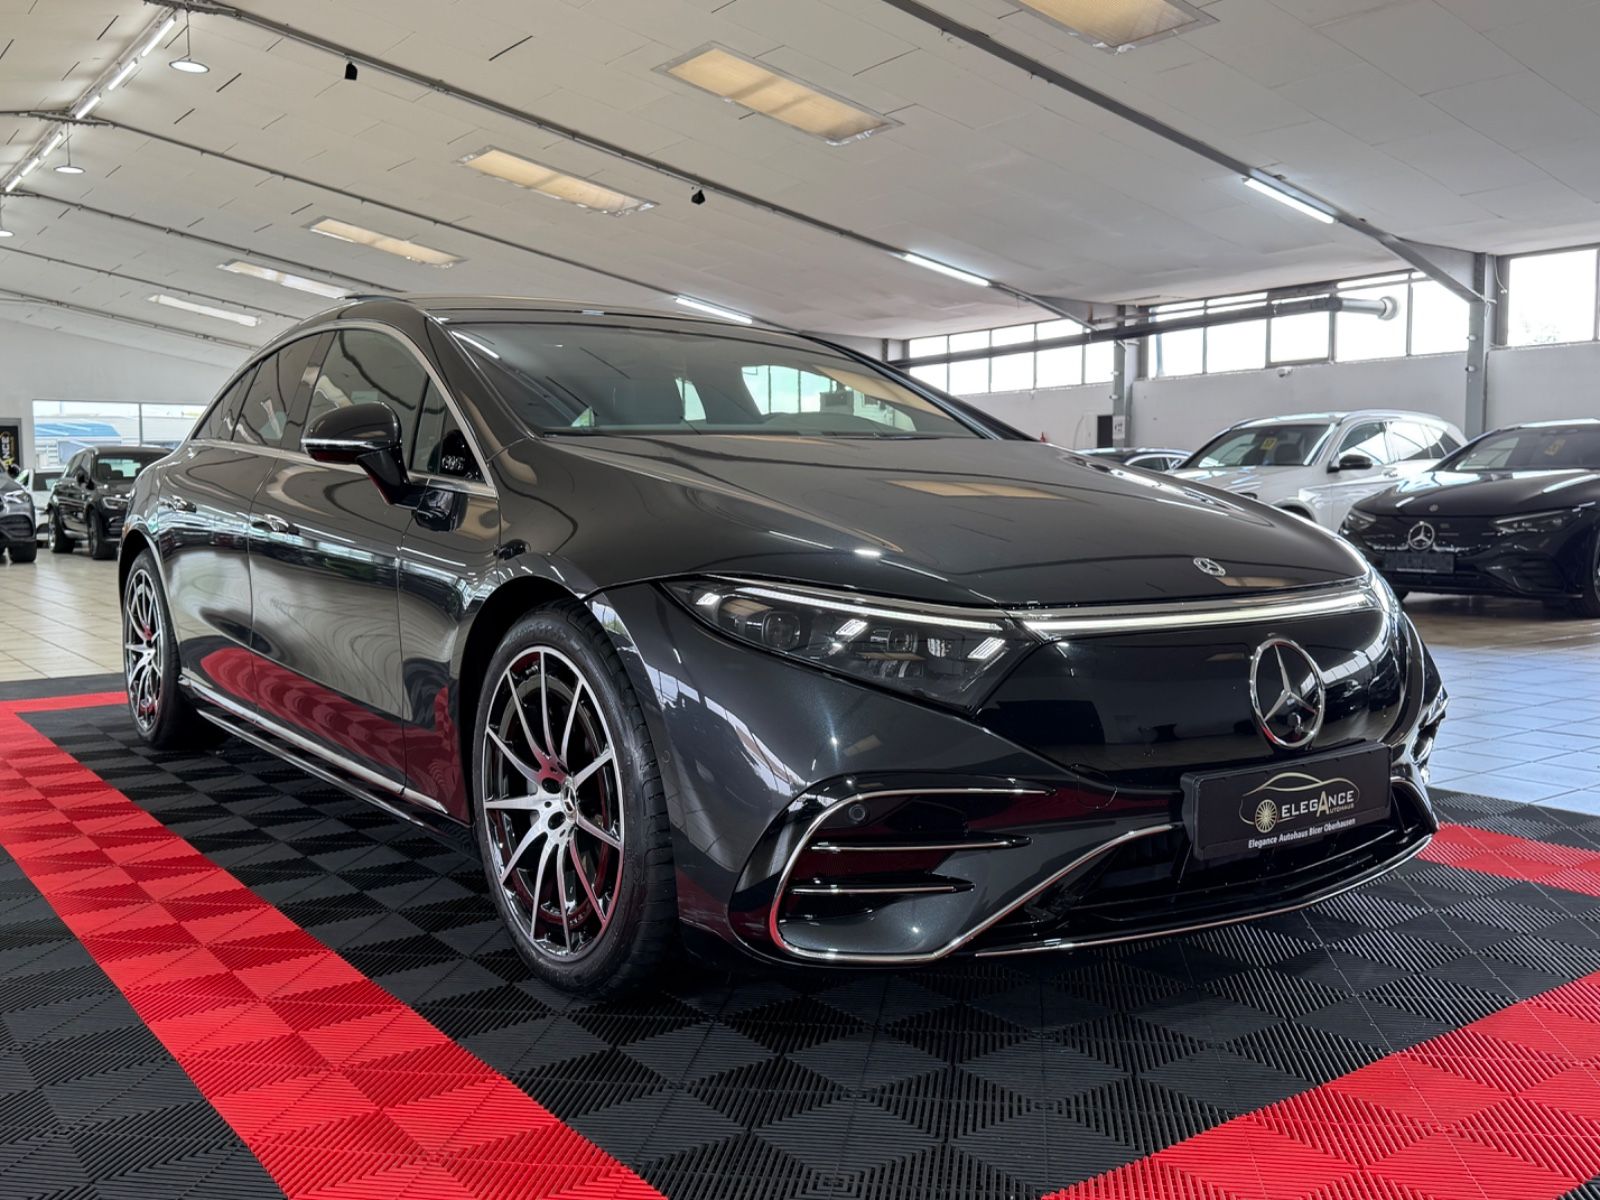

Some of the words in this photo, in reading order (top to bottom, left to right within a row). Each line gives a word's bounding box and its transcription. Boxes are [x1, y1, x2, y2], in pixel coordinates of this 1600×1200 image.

[1281, 790, 1355, 818] ELEGANCE
[1248, 837, 1278, 849] Elegance
[1278, 830, 1309, 843] Autohaus
[1323, 818, 1356, 832] Oberhausen
